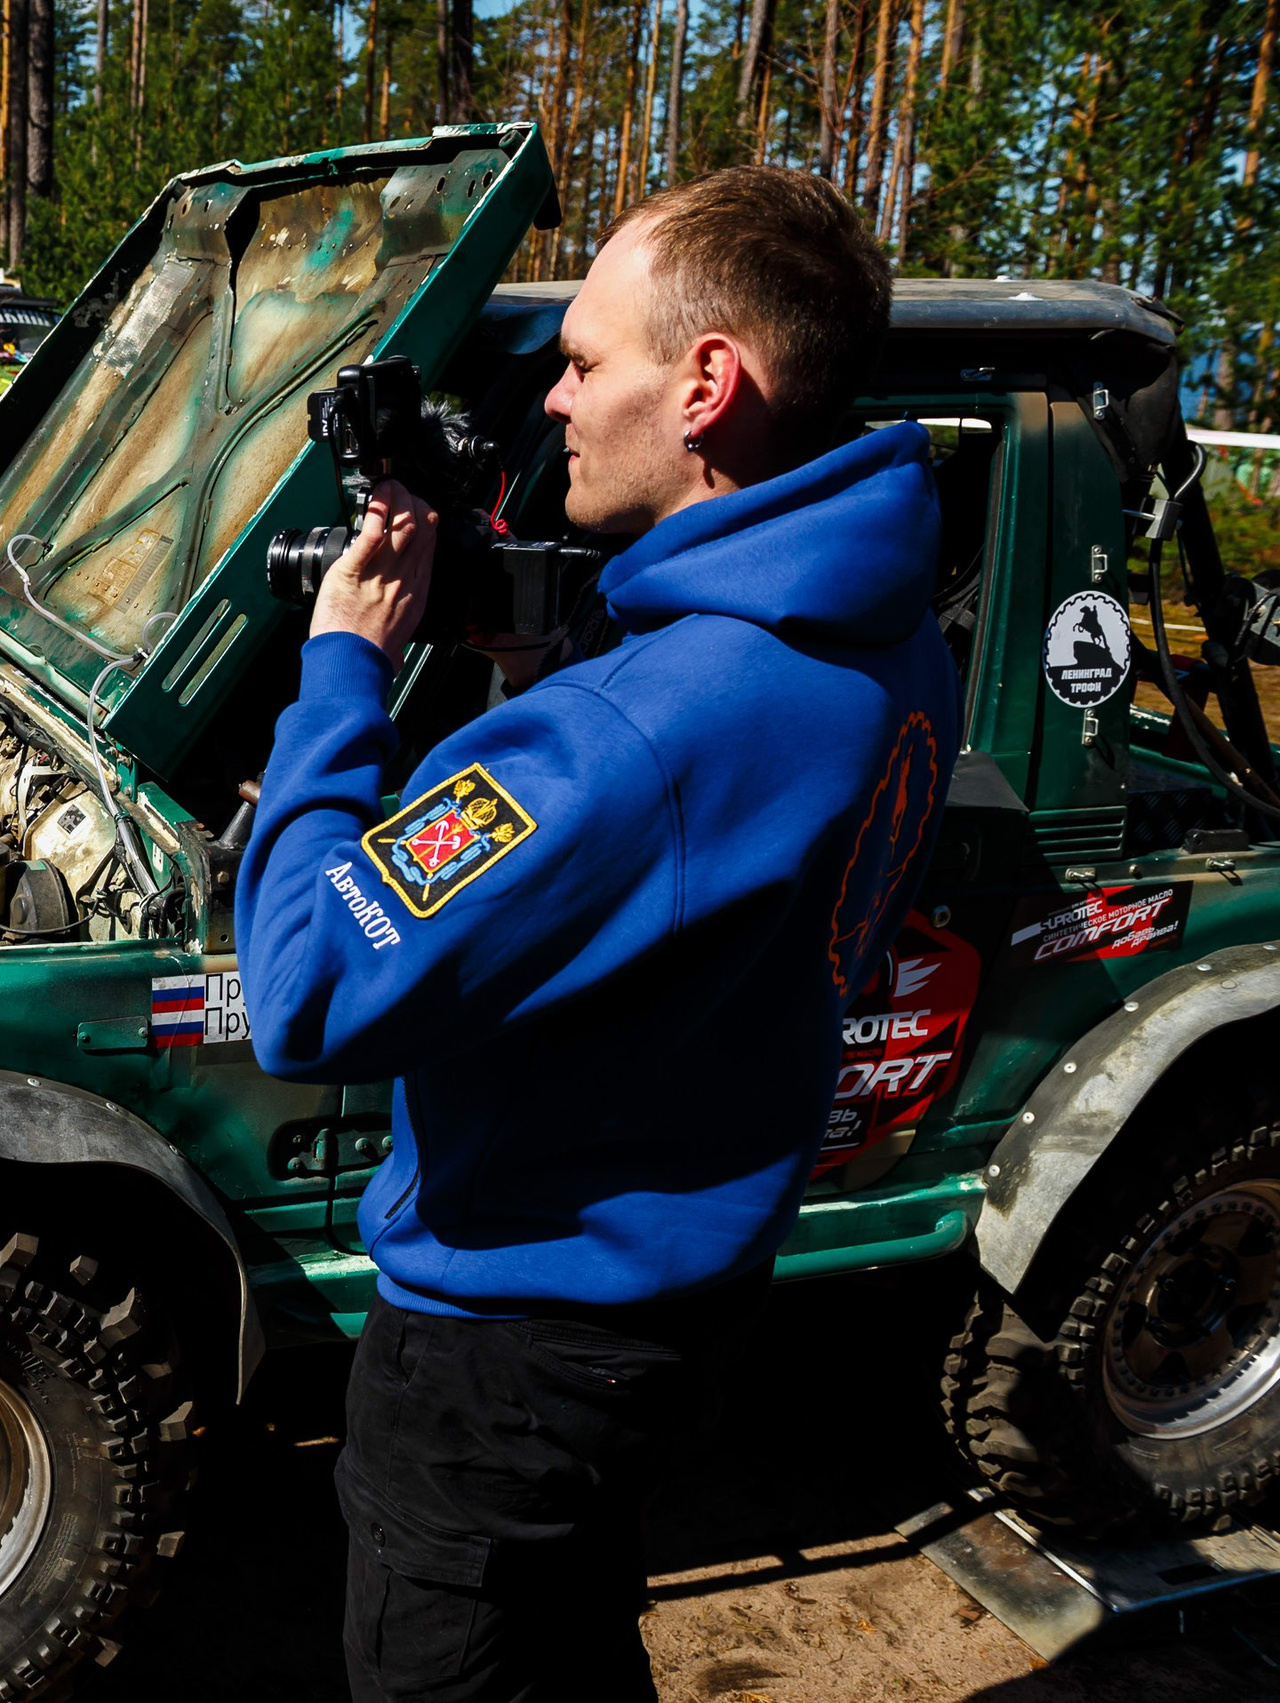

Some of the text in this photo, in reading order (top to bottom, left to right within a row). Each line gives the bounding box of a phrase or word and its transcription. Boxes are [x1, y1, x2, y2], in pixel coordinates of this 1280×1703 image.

[1061, 667, 1113, 681] ЛЕНИНГРАД
[1070, 682, 1103, 694] ТРОФИ
[1026, 900, 1104, 938] SUPROTEC
[1042, 914, 1108, 943] СИНТЕТИЧЕСКОЕ
[1108, 898, 1147, 919] МОТОРНОЕ
[1147, 888, 1174, 904] МАСЛО
